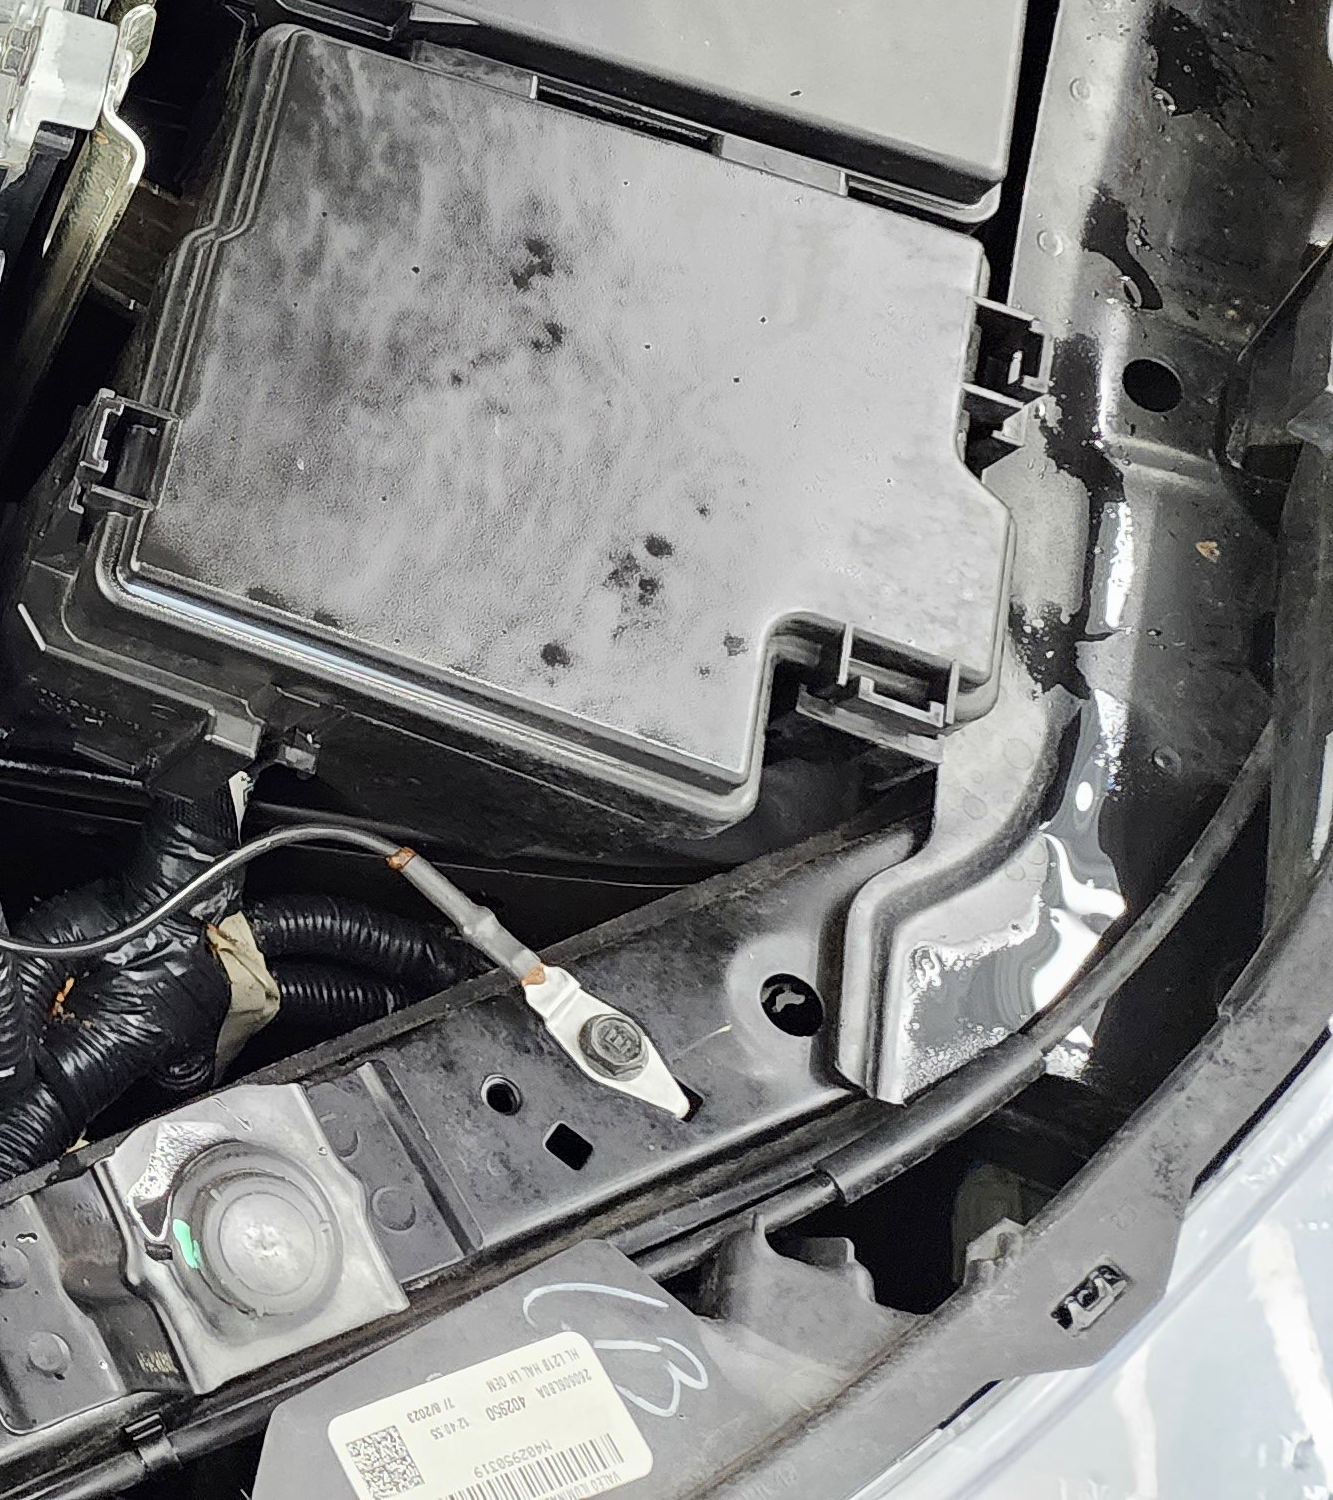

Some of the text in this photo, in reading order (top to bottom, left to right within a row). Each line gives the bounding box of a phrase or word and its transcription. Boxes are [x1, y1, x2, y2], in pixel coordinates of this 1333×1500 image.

[506, 1369, 519, 1385] LH
[520, 1361, 541, 1379] HAL
[485, 1375, 505, 1392] OEM
[484, 1394, 527, 1422] 402950
[472, 1438, 551, 1478] N402950319
